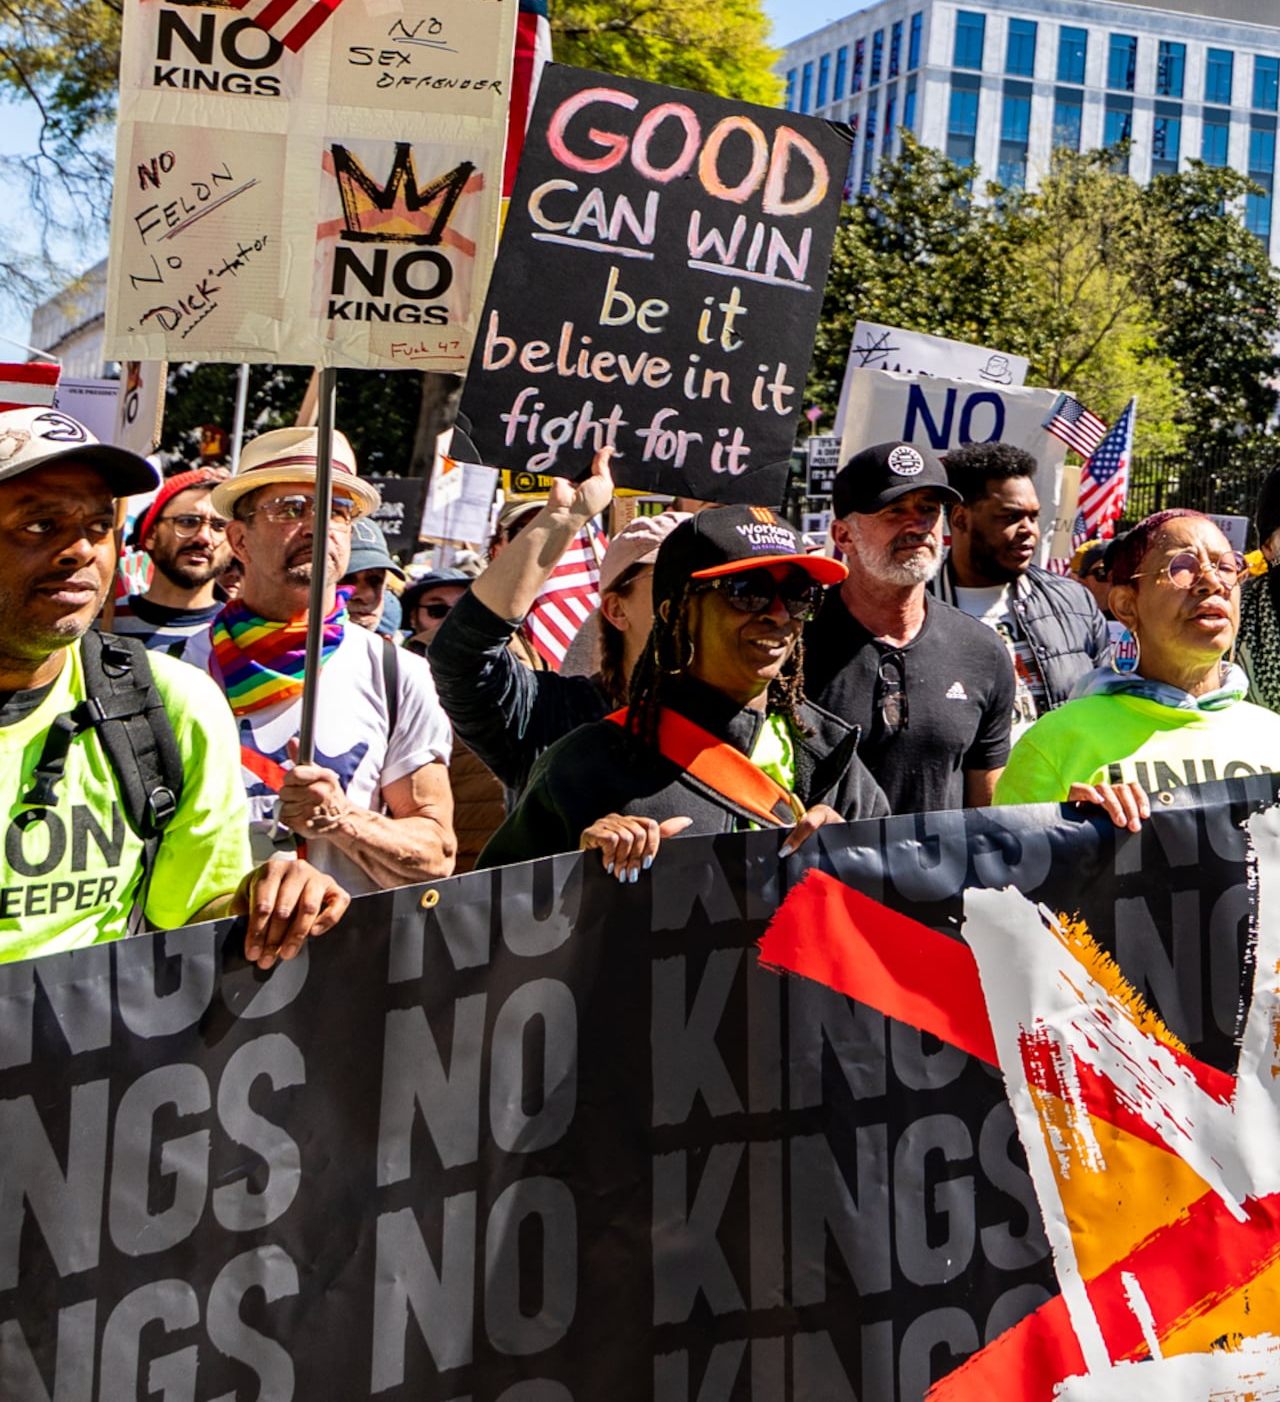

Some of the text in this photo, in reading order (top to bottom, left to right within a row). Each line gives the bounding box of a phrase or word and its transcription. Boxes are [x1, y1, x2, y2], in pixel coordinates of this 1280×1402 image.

[156, 8, 283, 69] NO
[347, 45, 413, 67] SEX
[388, 16, 445, 39] NO
[153, 65, 281, 96] KINGS
[376, 71, 503, 96] OFFENDER
[137, 150, 177, 191] NO
[547, 87, 829, 216] GOOD
[134, 162, 236, 246] FELON
[528, 178, 812, 283] CAN WIN
[330, 245, 454, 300] NO
[326, 300, 450, 326] KINGS
[599, 265, 748, 353] be it
[482, 309, 796, 416] believe in it
[500, 387, 752, 476] fight for it
[902, 383, 1006, 450] NO
[749, 533, 796, 550] United
[5, 799, 127, 877] ON
[0, 876, 118, 918] EEPER
[377, 977, 579, 1188] NO
[370, 1175, 578, 1396] NO
[651, 1098, 1056, 1326] KINGS
